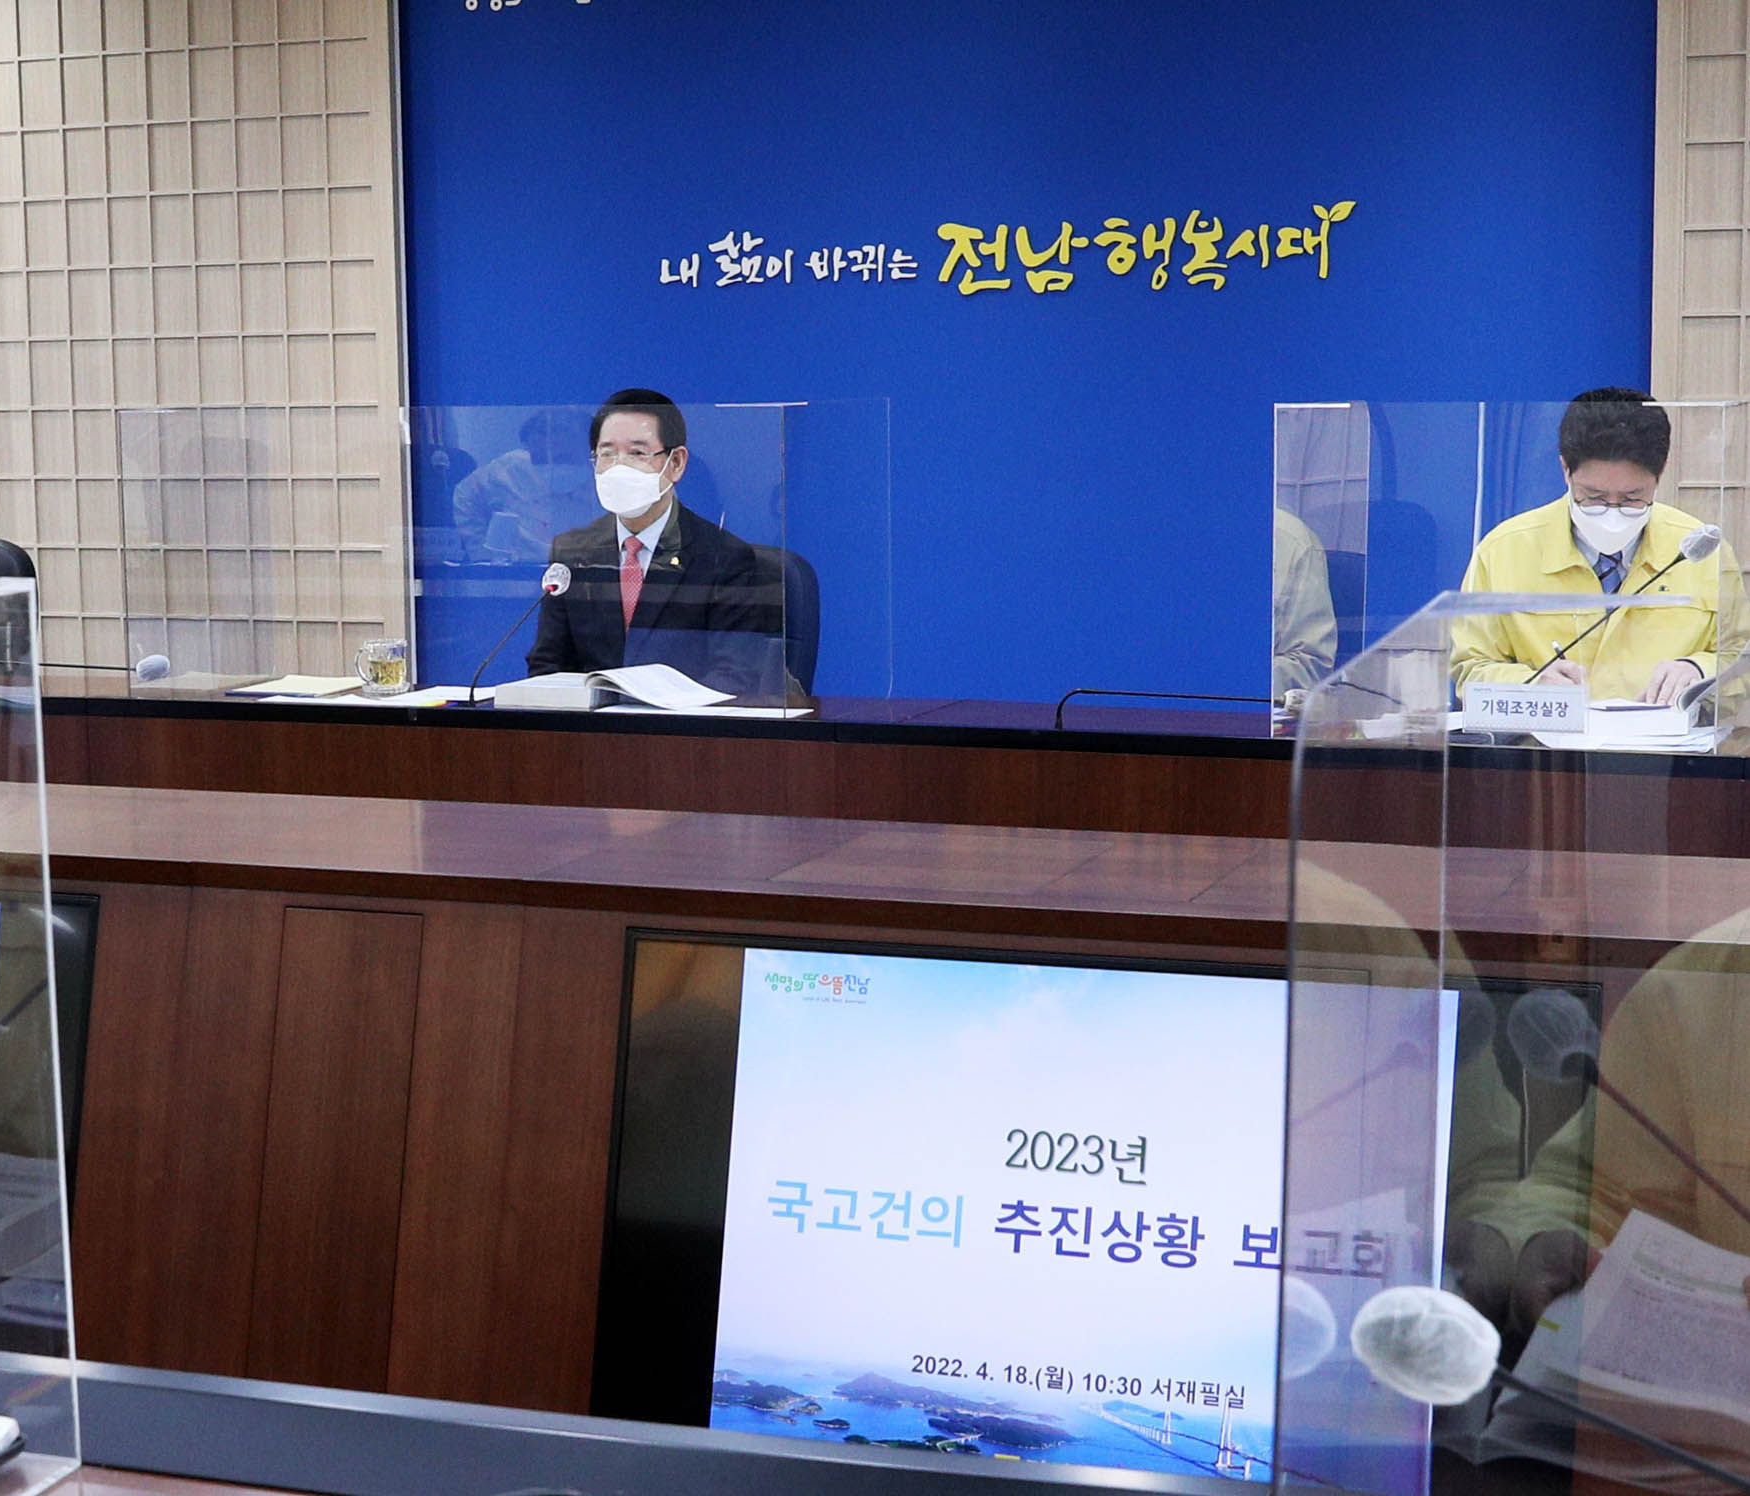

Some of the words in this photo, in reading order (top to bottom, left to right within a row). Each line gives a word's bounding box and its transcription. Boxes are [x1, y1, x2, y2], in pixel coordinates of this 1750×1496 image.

[659, 252, 700, 288] 내
[707, 230, 794, 288] 삶이
[805, 243, 918, 282] 바뀌는
[1481, 699, 1569, 718] 기획조정실장
[1004, 1128, 1149, 1187] 2023년
[767, 1180, 965, 1249] 국고건의
[993, 1200, 1206, 1270] 추진상황
[1233, 1223, 1387, 1285] 보고회
[911, 1354, 969, 1380] 2022.
[975, 1362, 995, 1382] 4.
[1082, 1372, 1142, 1397] 10:30
[1150, 1377, 1246, 1410] 서재필실
